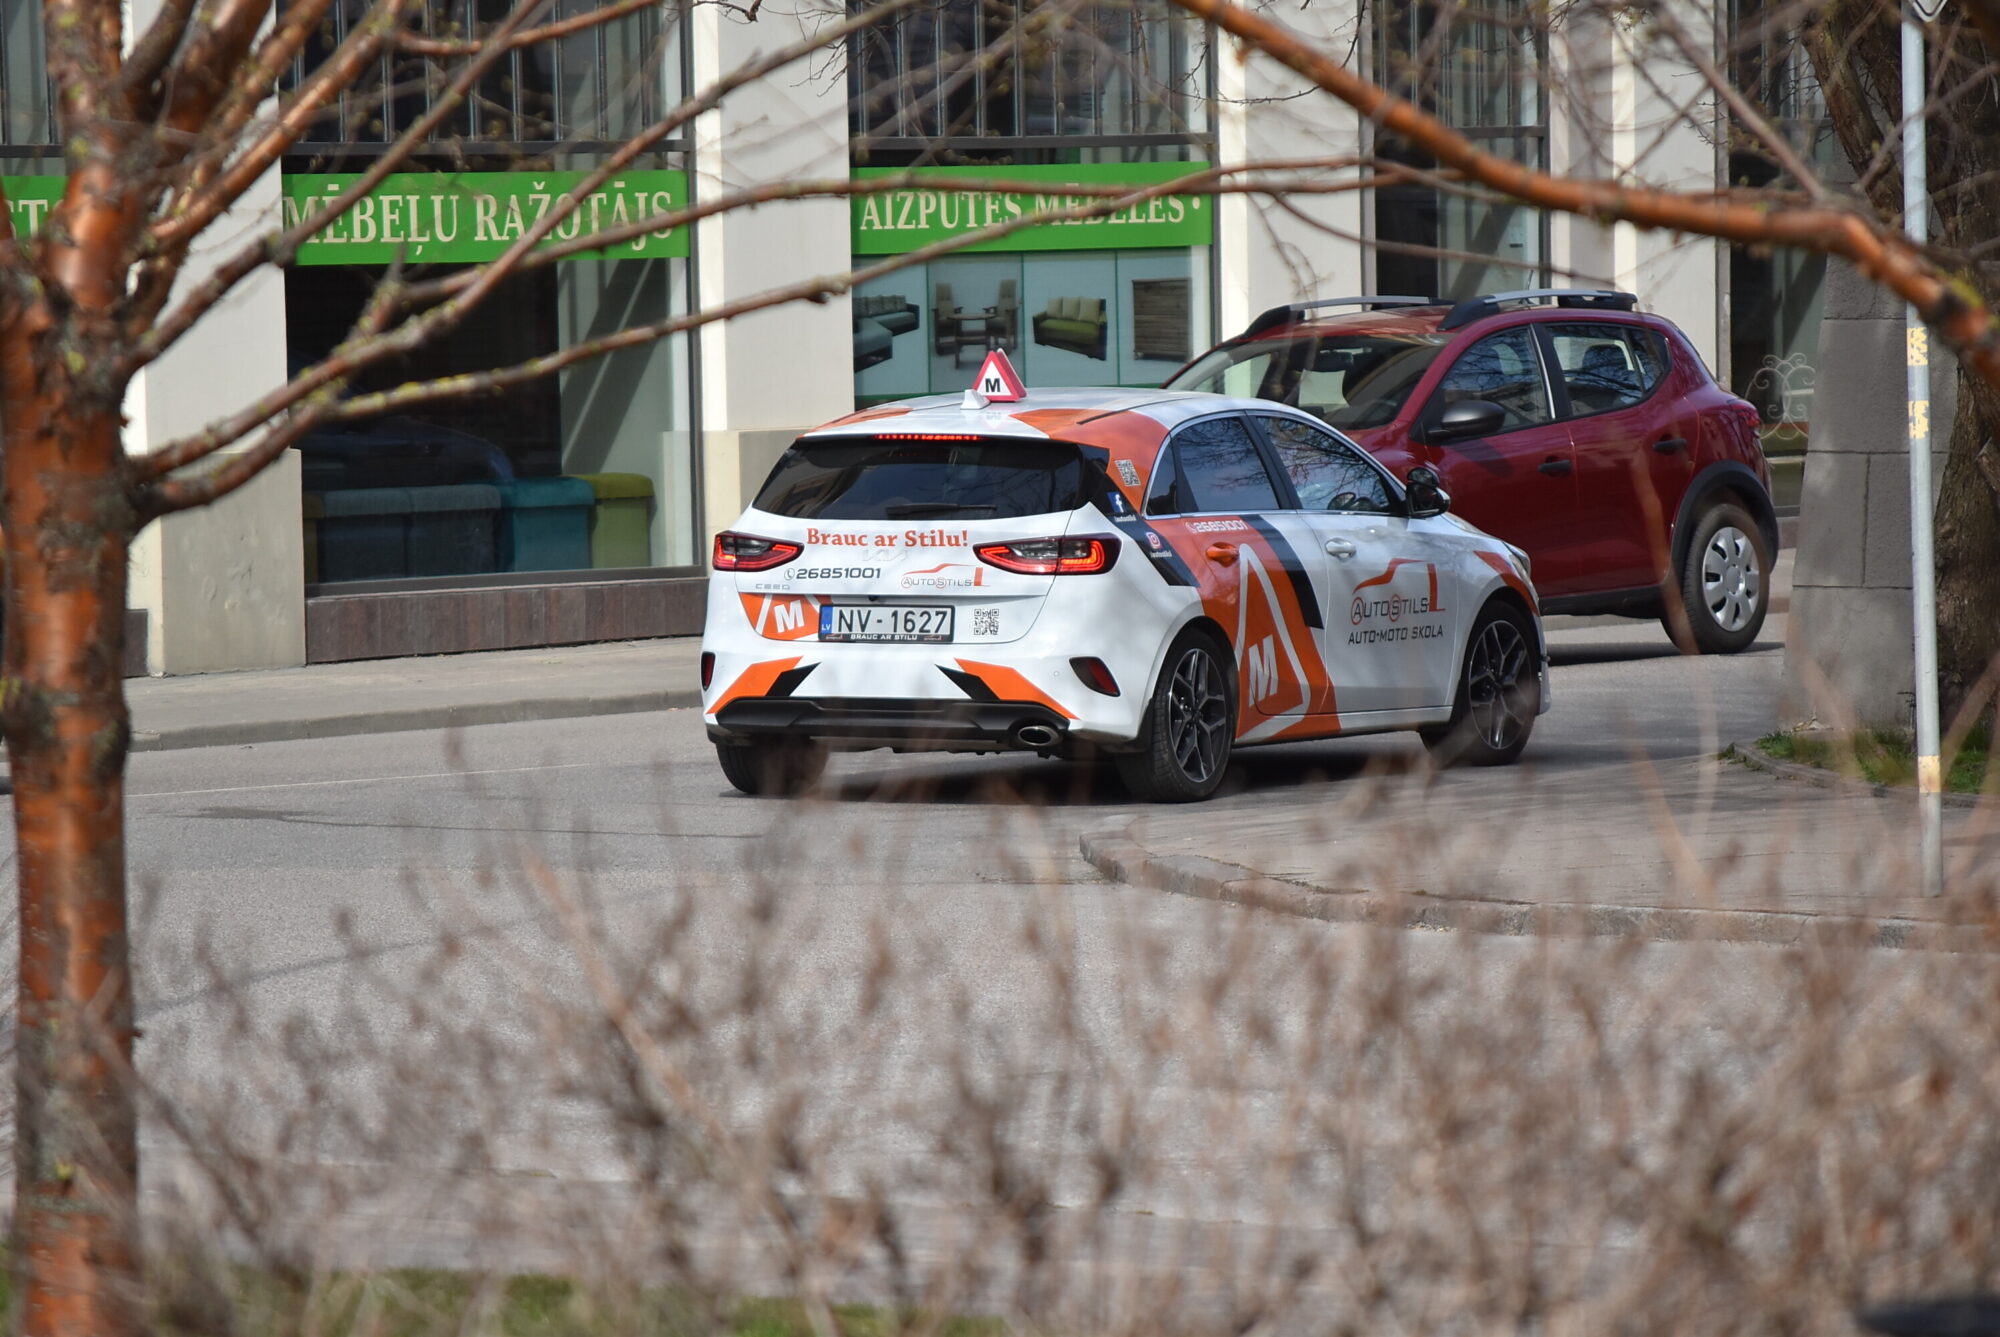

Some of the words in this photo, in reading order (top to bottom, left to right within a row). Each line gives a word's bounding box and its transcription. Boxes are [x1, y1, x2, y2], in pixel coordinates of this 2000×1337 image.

[283, 183, 459, 255] MĒBEĻU
[474, 181, 673, 251] RAŽOTĀJS
[860, 189, 1022, 231] AIZPUTES
[985, 378, 1001, 393] M
[807, 528, 868, 546] Brauc
[874, 534, 898, 547] ar
[904, 529, 969, 547] Stilu!
[796, 567, 881, 579] 26851001
[774, 599, 805, 633] M
[838, 609, 948, 634] NV-1627
[850, 633, 878, 641] BRAUC
[881, 633, 892, 641] AR
[894, 633, 918, 641] STILU
[1411, 624, 1443, 639] SKOLA
[1249, 634, 1279, 708] M
